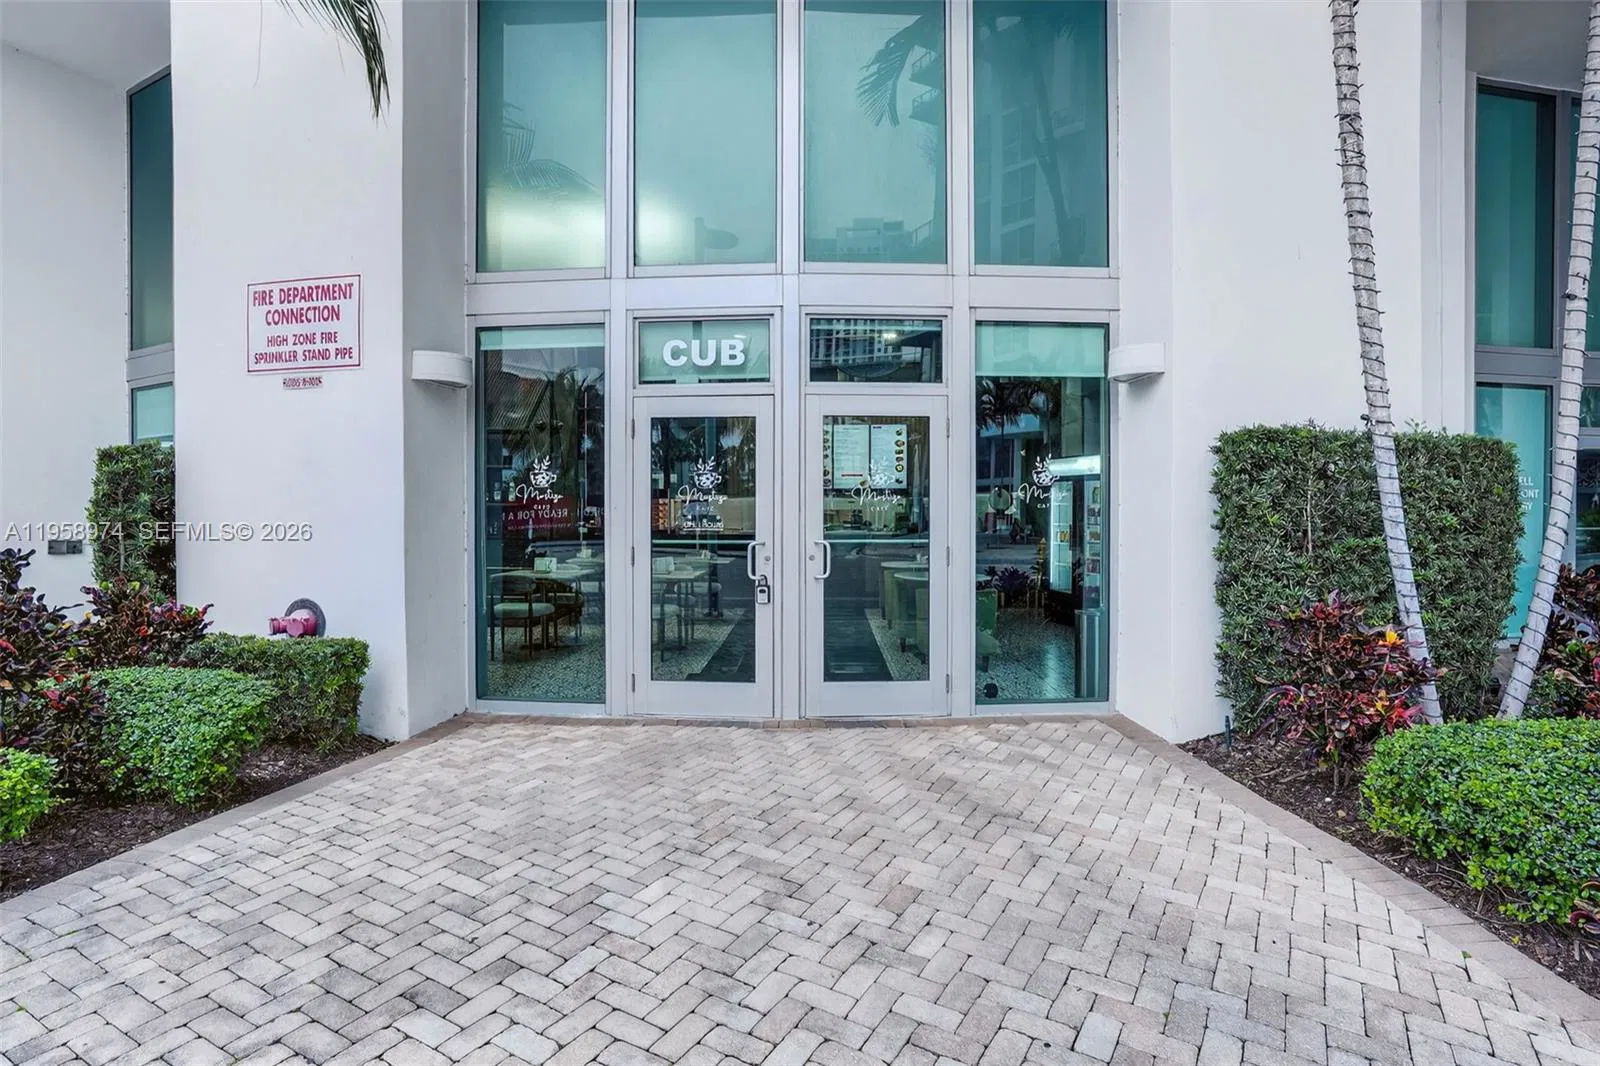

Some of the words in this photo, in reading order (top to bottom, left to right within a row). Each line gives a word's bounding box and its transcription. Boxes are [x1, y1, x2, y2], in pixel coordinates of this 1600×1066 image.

[253, 289, 274, 306] FIRE
[279, 283, 354, 304] DEPARTMENT
[265, 304, 341, 326] CONNECTION
[267, 335, 289, 347] HIGH
[292, 332, 317, 346] ZONE
[320, 331, 338, 344] FIRE
[254, 350, 298, 365] SPRINKLER
[302, 348, 331, 361] STAND
[335, 346, 353, 360] PIPE
[1518, 476, 1534, 486] ELL
[1519, 489, 1540, 498] ONT
